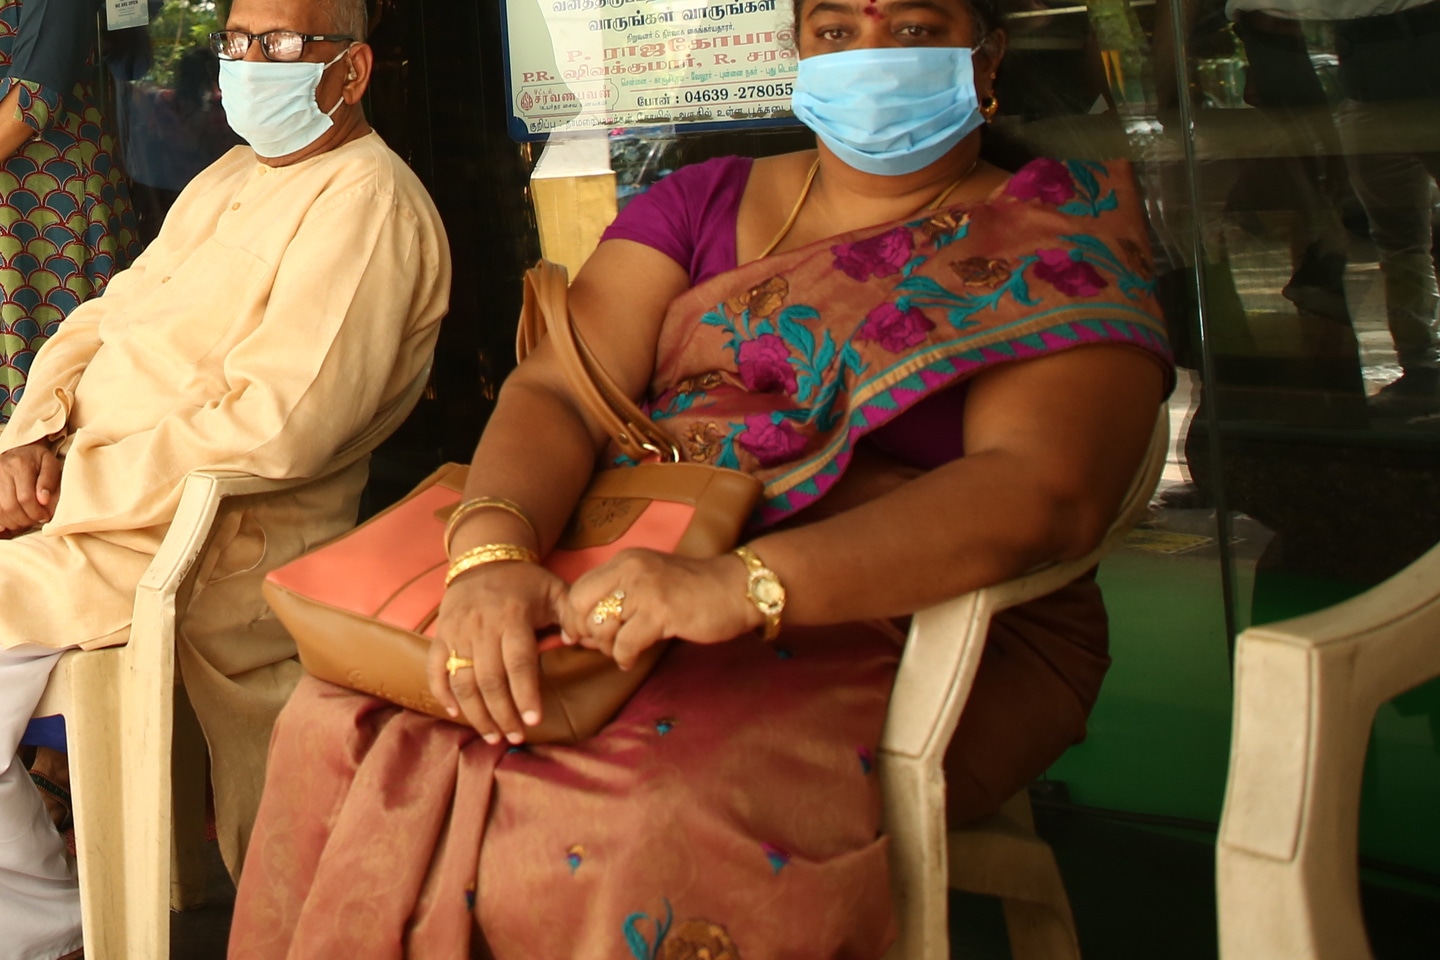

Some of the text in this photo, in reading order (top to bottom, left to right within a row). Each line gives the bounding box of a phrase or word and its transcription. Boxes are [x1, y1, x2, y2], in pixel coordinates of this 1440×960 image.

[636, 82, 794, 111] போன் 04639 -278055
